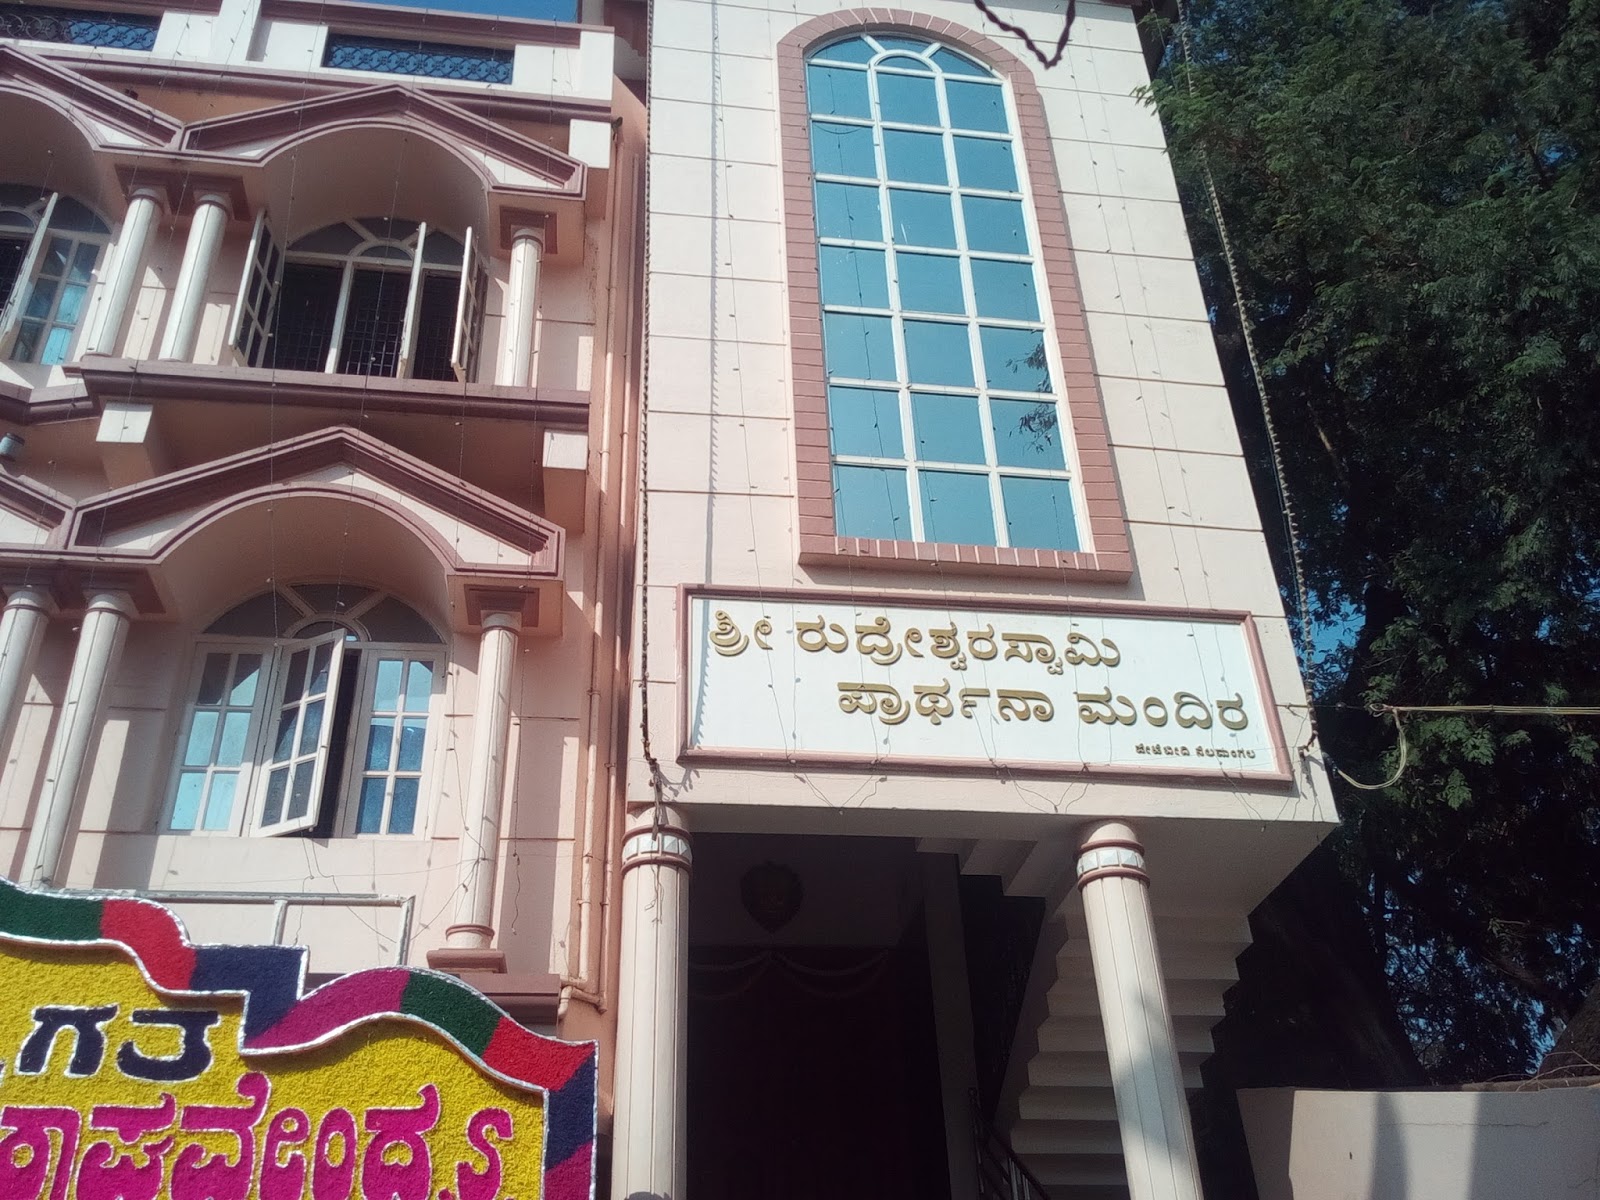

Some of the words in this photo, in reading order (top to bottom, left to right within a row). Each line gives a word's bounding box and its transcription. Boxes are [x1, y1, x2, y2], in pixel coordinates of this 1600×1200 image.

[709, 609, 774, 657] ಶ್ರೀ
[795, 614, 1121, 676] ರುದ್ರೇಶ್ವರಸ್ವಾಮಿ
[837, 677, 1055, 726] ಪ್ರಾರ್ಥನಾ
[1077, 686, 1249, 731] ಮಂದಿರ
[0, 1002, 222, 1083] ಗತ
